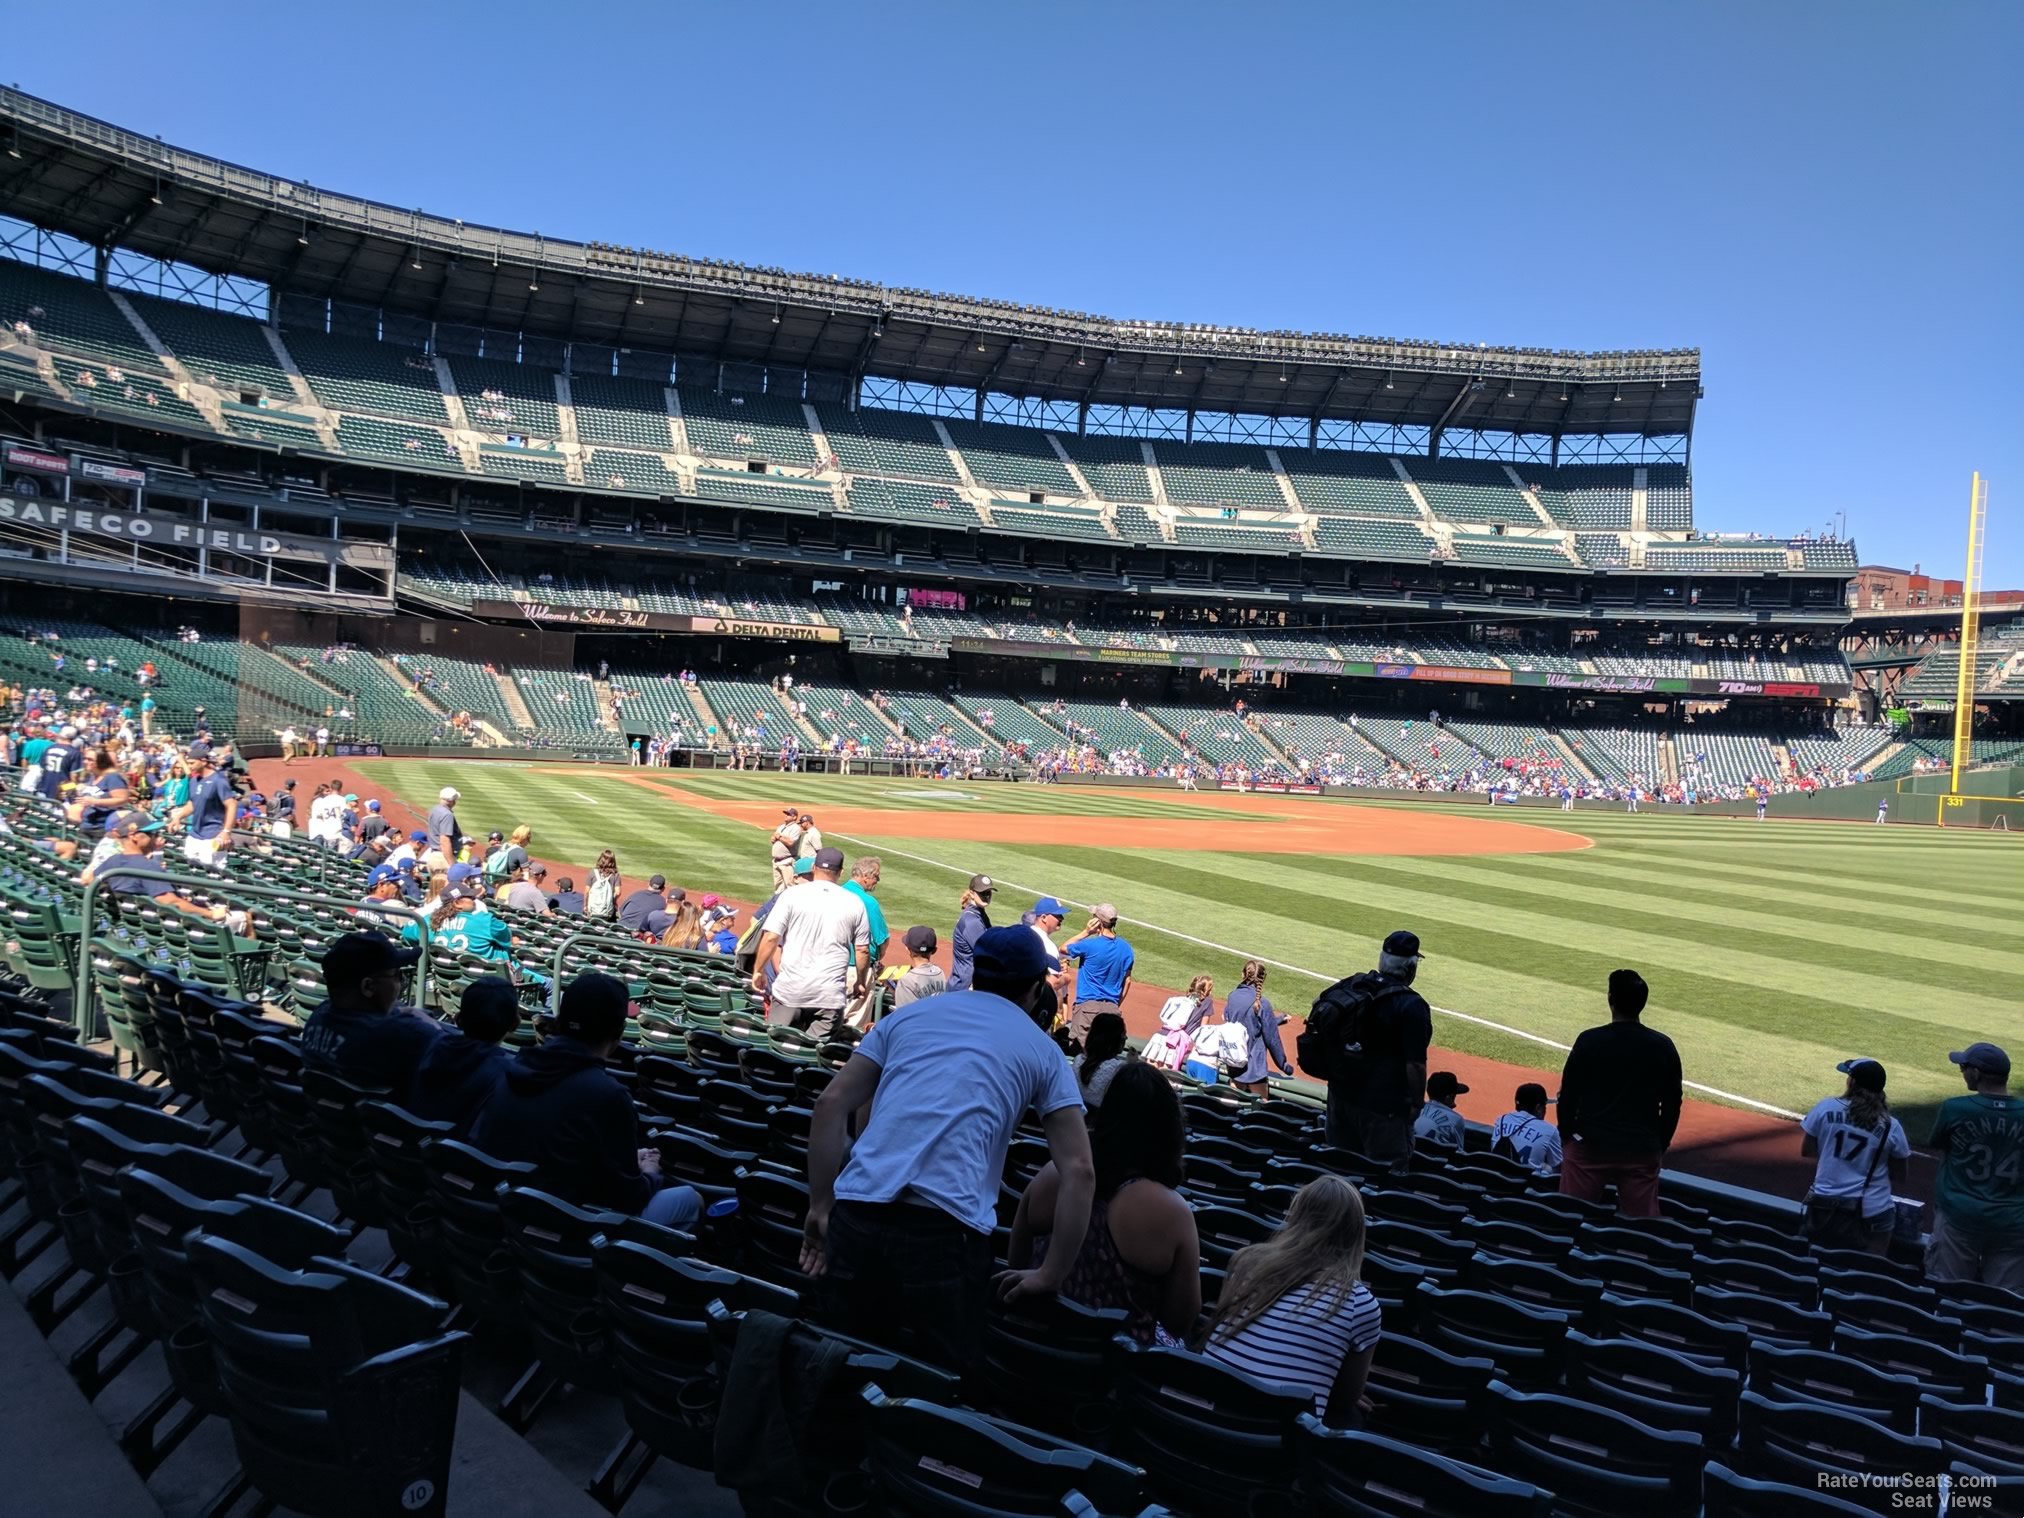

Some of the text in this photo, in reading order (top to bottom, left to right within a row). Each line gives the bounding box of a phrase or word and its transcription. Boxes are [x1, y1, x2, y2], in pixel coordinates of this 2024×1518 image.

[9, 451, 36, 464] ROOT
[0, 498, 281, 553] SAFECO FIELD
[523, 604, 648, 626] Welcome to Safeco Field
[732, 624, 821, 639] DELTA DENTAL
[1546, 674, 1655, 690] Welcome to Safeco Field
[1719, 682, 1745, 693] 710
[1763, 684, 1819, 696] ESPN
[46, 755, 62, 772] 51
[1947, 798, 1963, 807] 331
[324, 807, 337, 820] 34
[1951, 1116, 2024, 1151] HERNAN
[1834, 1130, 1868, 1161] 17
[1965, 1144, 2022, 1186] 34
[410, 1486, 426, 1504] 10
